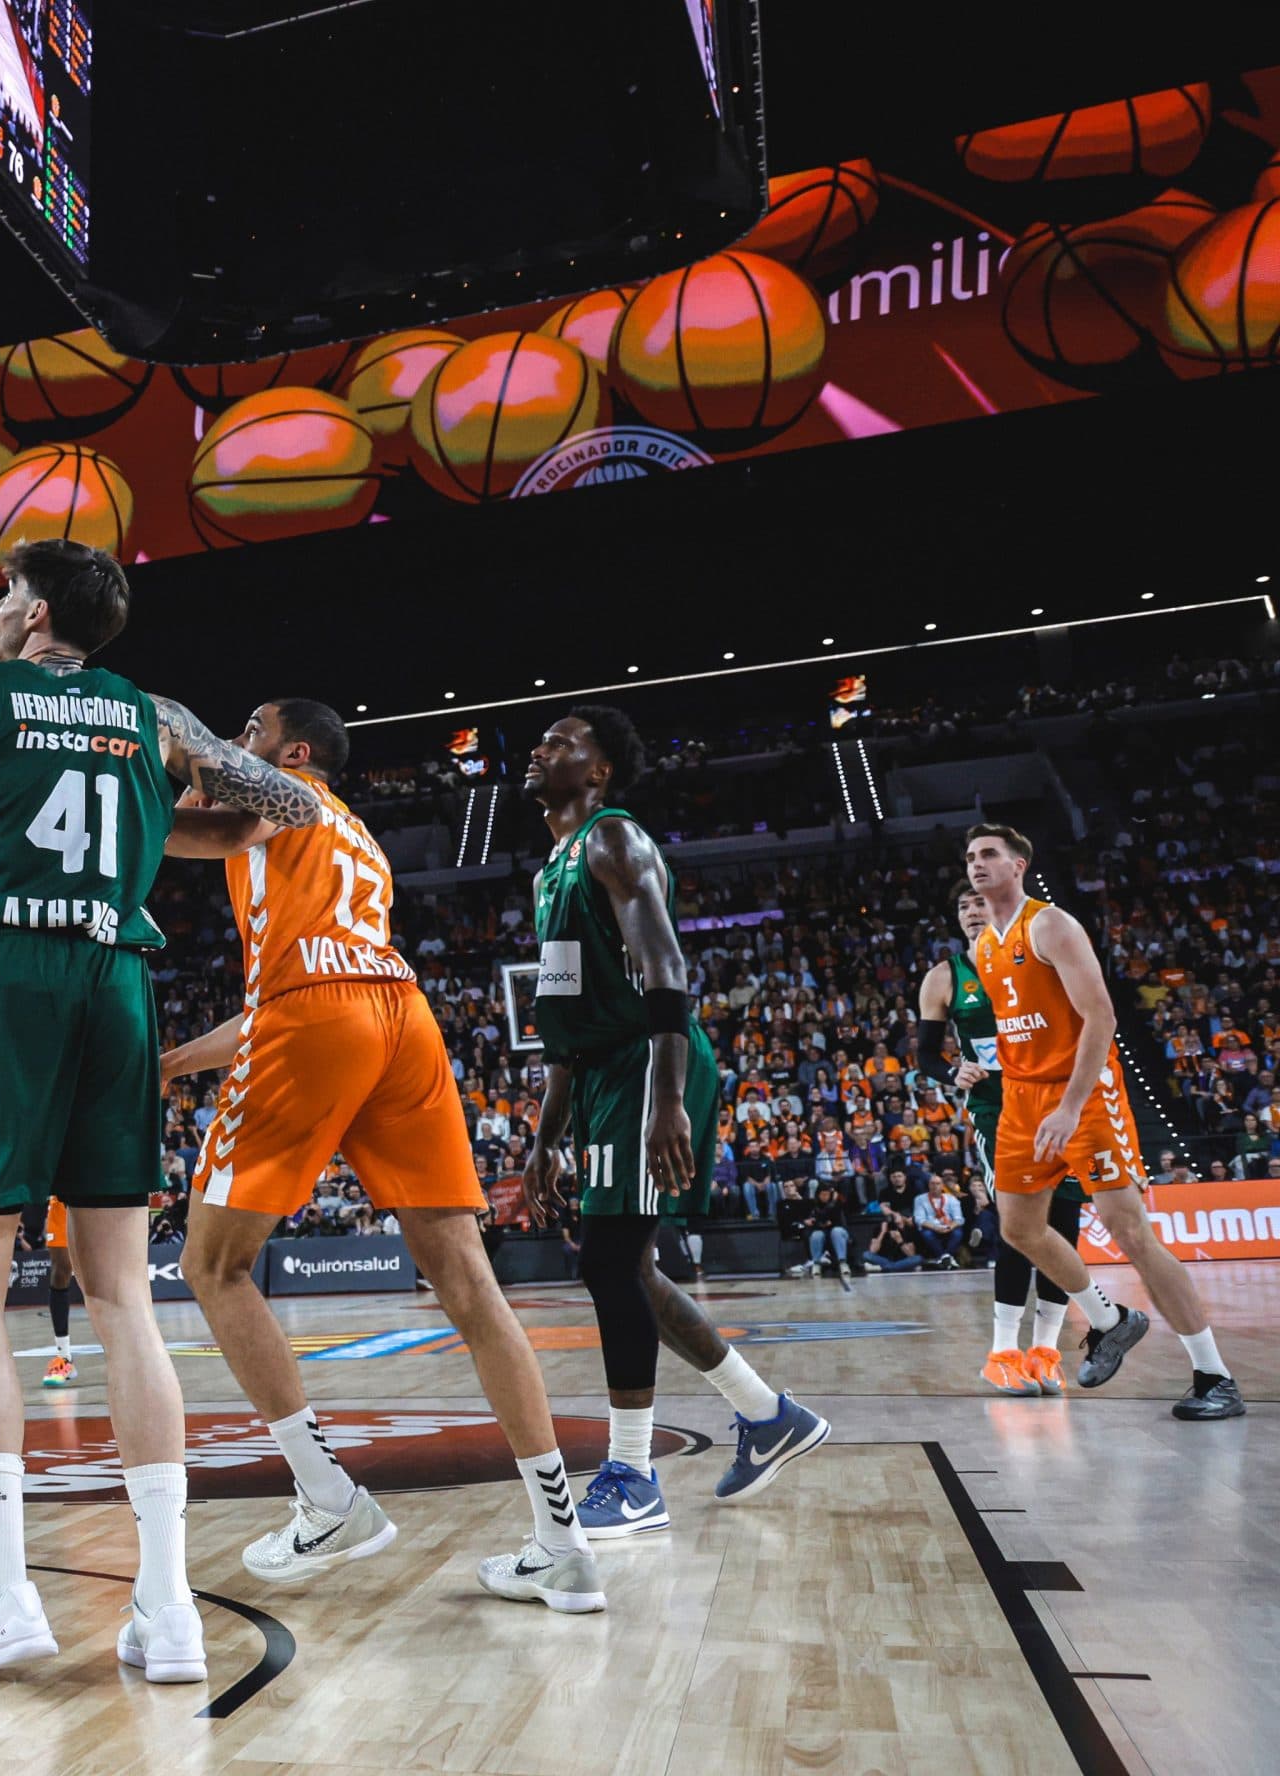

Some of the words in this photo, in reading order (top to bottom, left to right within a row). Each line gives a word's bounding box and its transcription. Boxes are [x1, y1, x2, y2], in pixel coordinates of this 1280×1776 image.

[829, 232, 1012, 324] mili
[10, 692, 140, 733] HERNANGOMEZ
[16, 723, 140, 759] instacar
[25, 769, 119, 878] 41
[333, 849, 386, 948] 13
[1002, 976, 1018, 1008] 3
[588, 1144, 615, 1188] 11
[1094, 1150, 1120, 1182] 3
[20, 1275, 39, 1285] club
